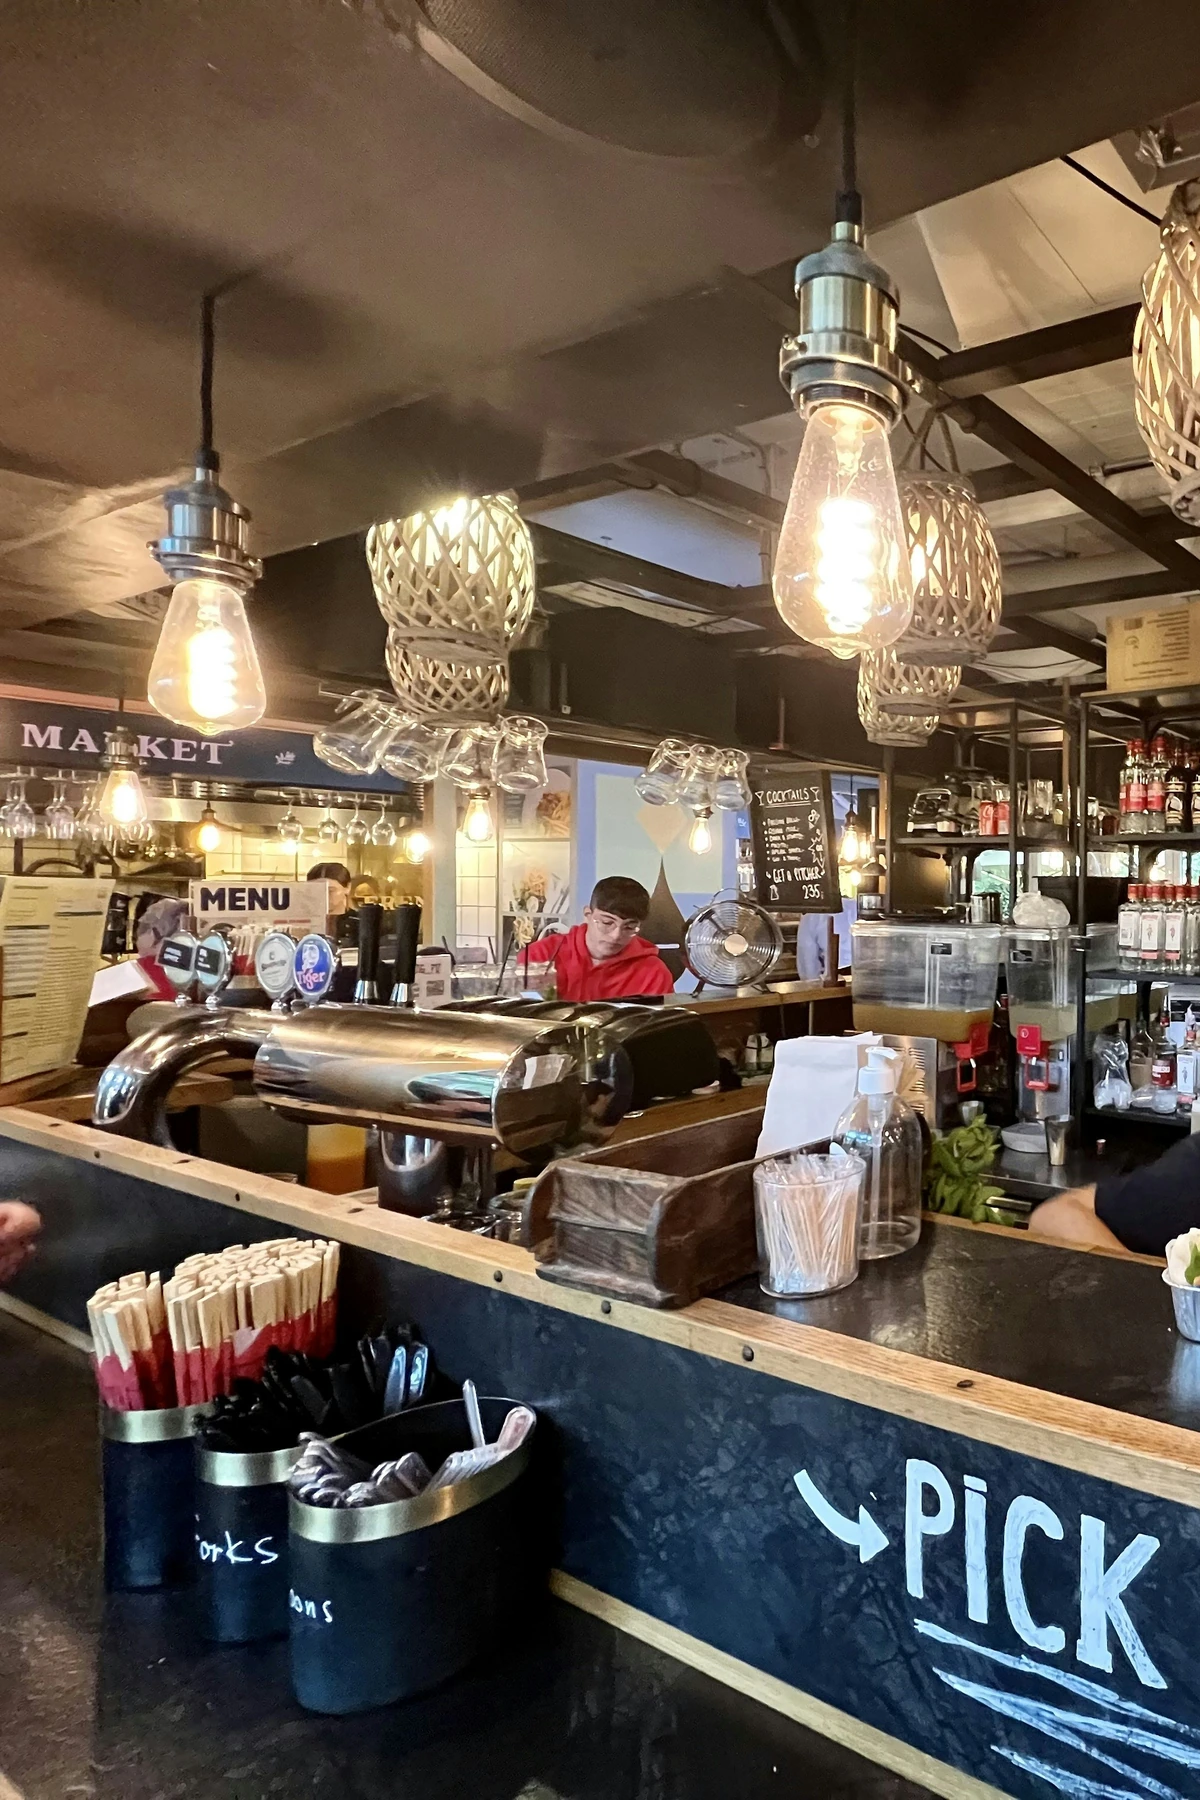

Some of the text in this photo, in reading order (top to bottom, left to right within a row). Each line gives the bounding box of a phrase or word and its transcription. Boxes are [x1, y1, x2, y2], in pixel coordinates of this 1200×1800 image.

[21, 722, 234, 765] MAKET
[766, 788, 810, 803] COCKTAILS
[773, 868, 785, 883] GET
[794, 867, 821, 882] PITCHER
[200, 887, 290, 912] MENU
[802, 884, 821, 899] 235
[296, 969, 326, 990] Tiger
